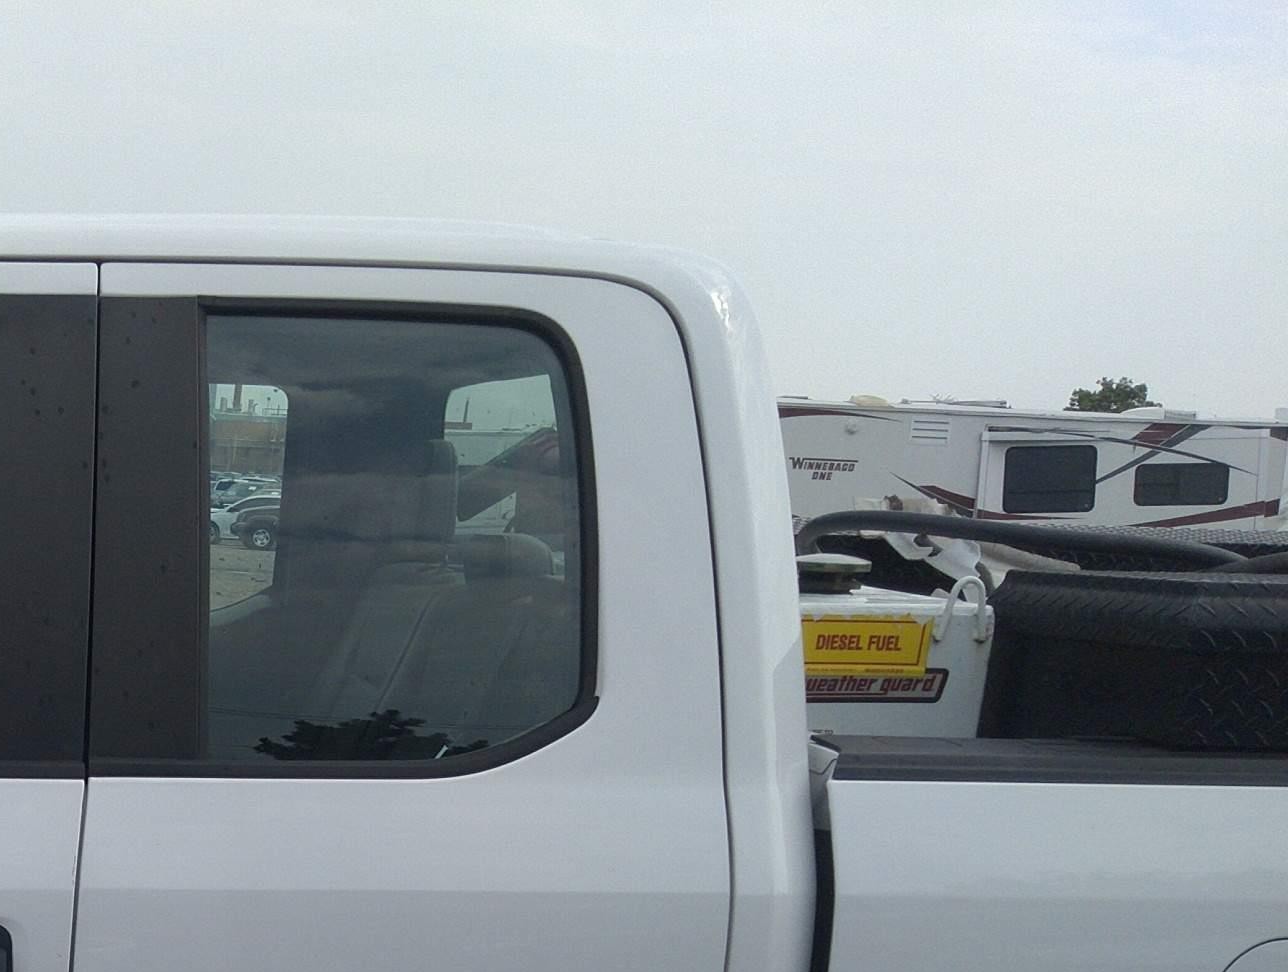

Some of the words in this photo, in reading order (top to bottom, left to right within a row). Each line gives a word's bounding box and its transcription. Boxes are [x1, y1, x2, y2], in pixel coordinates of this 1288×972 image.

[812, 471, 833, 481] ONE
[816, 634, 863, 651] DIESEL
[867, 635, 902, 652] FUEL
[879, 676, 937, 695] guard
